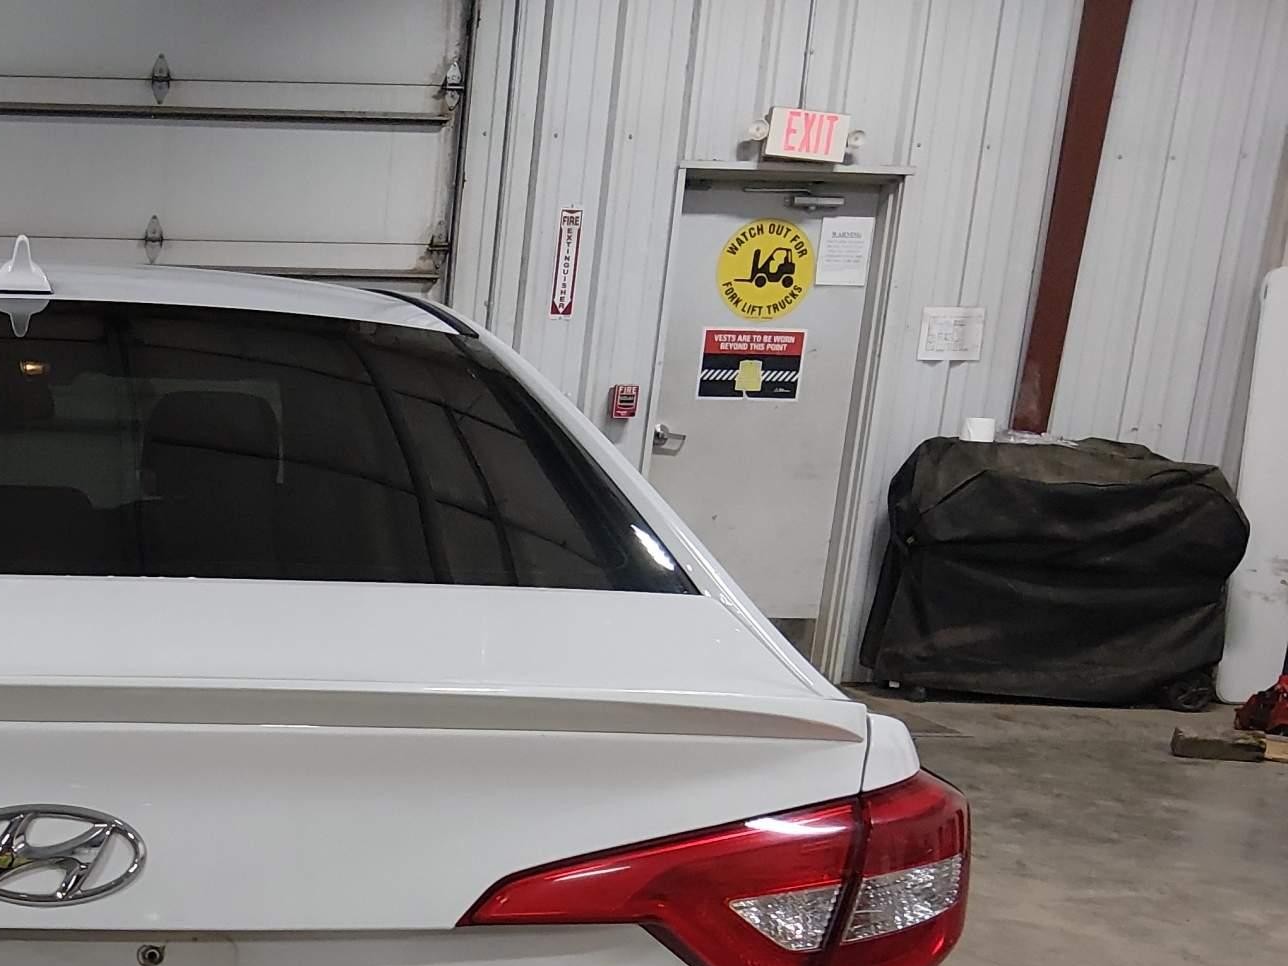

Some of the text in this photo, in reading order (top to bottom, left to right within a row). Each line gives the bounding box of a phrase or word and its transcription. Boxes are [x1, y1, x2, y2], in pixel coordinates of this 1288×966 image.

[783, 111, 839, 155] EXIT
[562, 216, 580, 226] FIRE
[727, 223, 764, 256] WATCH
[768, 223, 792, 237] OUT
[790, 234, 808, 258] FOR
[558, 228, 573, 309] EXTINGUISHER
[722, 281, 803, 316] FORK LIFT TRUCKS
[752, 335, 762, 343] TO
[763, 335, 772, 343] BE
